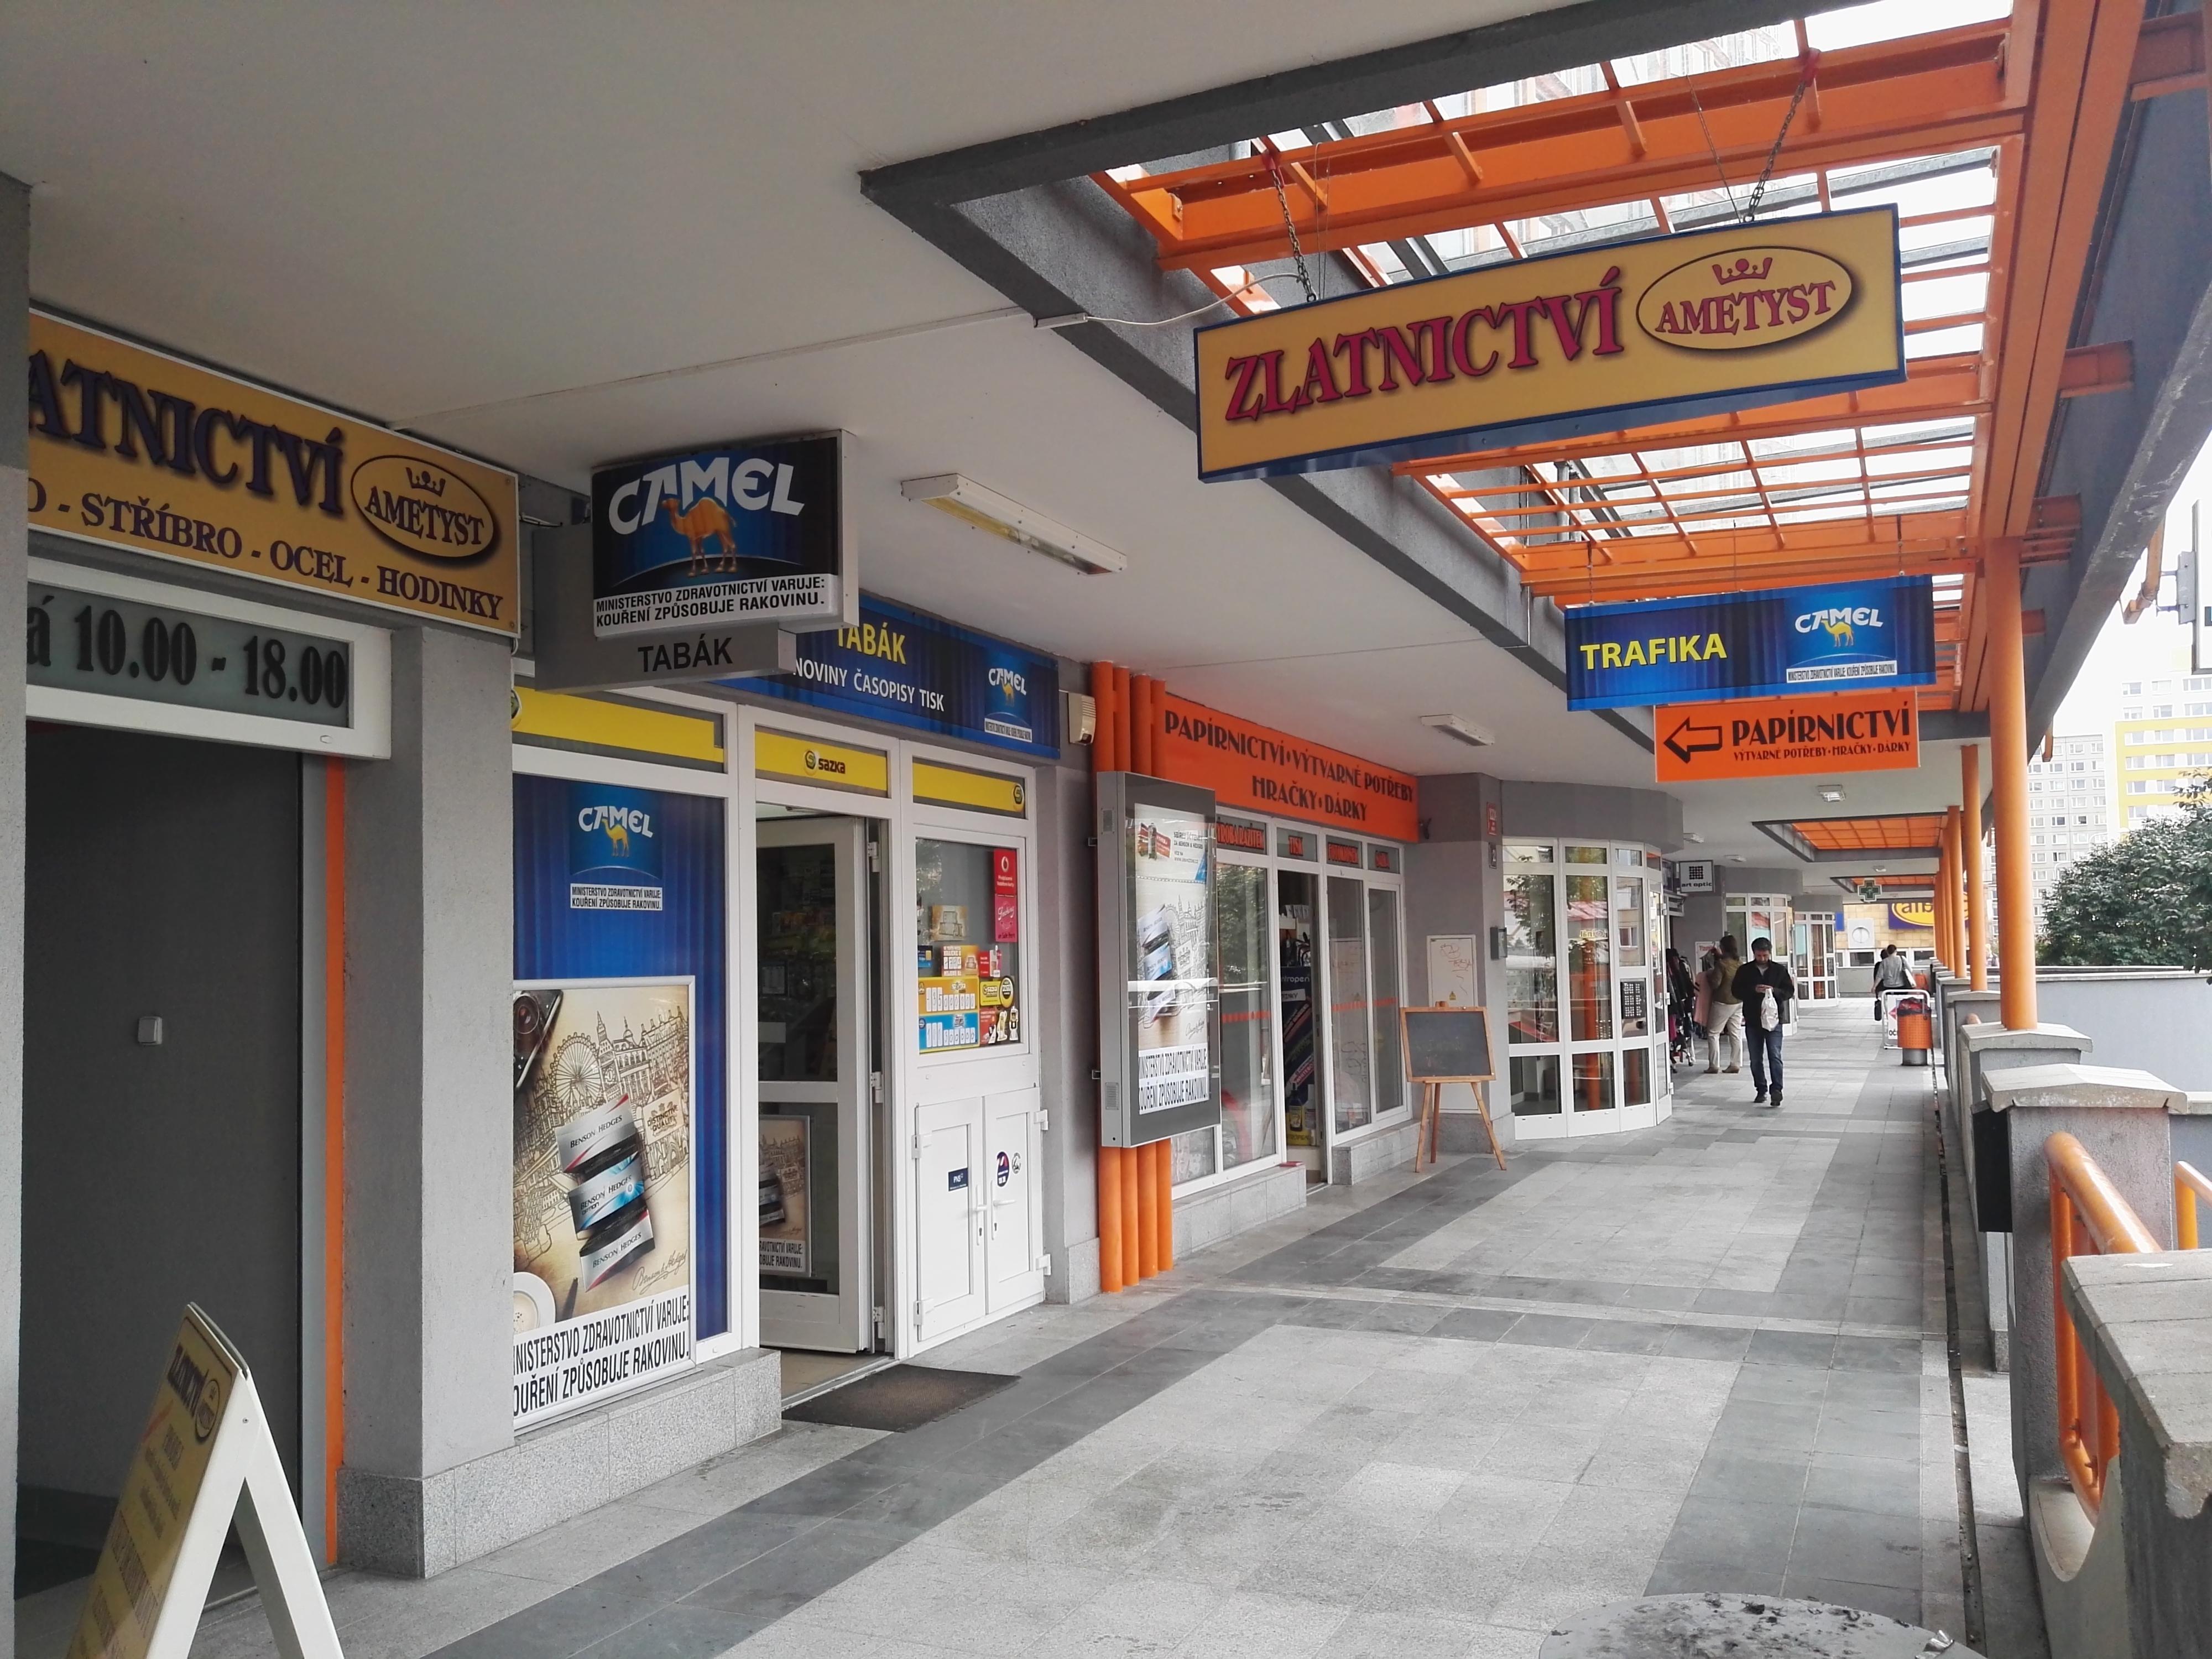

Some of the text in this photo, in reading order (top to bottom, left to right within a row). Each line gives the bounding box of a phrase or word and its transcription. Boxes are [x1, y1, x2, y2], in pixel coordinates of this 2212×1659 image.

[1655, 281, 1837, 336] AMETYST
[1225, 266, 1624, 421] ZLATNICTVÍ
[365, 486, 486, 546] AMETYST
[609, 457, 805, 535] CAMEL
[81, 493, 242, 559] STŘÍBRO
[270, 541, 354, 588] OCEL
[377, 566, 504, 620] HODINKY
[596, 576, 825, 613] MINISTERSTVO ZDRAVOTNICTVÍ VARUJE:
[596, 592, 825, 628] KOUŘENÍ ZPŮSOBUJE RAKOVINU.
[1794, 607, 1884, 634] CAMEL
[74, 605, 197, 686] 10.00
[243, 635, 349, 709] 18.00
[637, 634, 733, 673] TABÁK
[837, 622, 906, 665] TABÁK
[1580, 633, 1728, 671] TRAFIKA
[792, 657, 945, 712] NOVINY ČASOPISY TISK
[988, 668, 1027, 695] CAMEL
[1732, 701, 1910, 747] PAPÍRNICTVÍ
[1165, 709, 1415, 803] PAPÍRNICTVÍ VÝTVARNÉ POTŘEBY
[1734, 740, 1911, 761] VÝTVARNÉ POTŘEBY HRAČKY DÁRKY
[1251, 775, 1368, 822] HRAČKY DÁRKY
[578, 806, 654, 838] CAMEL
[572, 886, 661, 899] MINISTERSTVO ZDRAVOTNICTVÍ VARUJE:
[572, 896, 661, 910] KOUŘENÍ ZPŮSOBUJE RAKOVINU.
[570, 1115, 622, 1148] BENSON HEDGES
[581, 1175, 632, 1210] BENSON HEDGES
[593, 1232, 641, 1268] BENSON HEDGES
[582, 1299, 655, 1354] ZDRAVOTNICTVÍ
[656, 1294, 690, 1328] VARUJE:
[562, 1354, 629, 1401] ZPŮSOBUJE
[633, 1331, 690, 1374] RAKOVINU.
